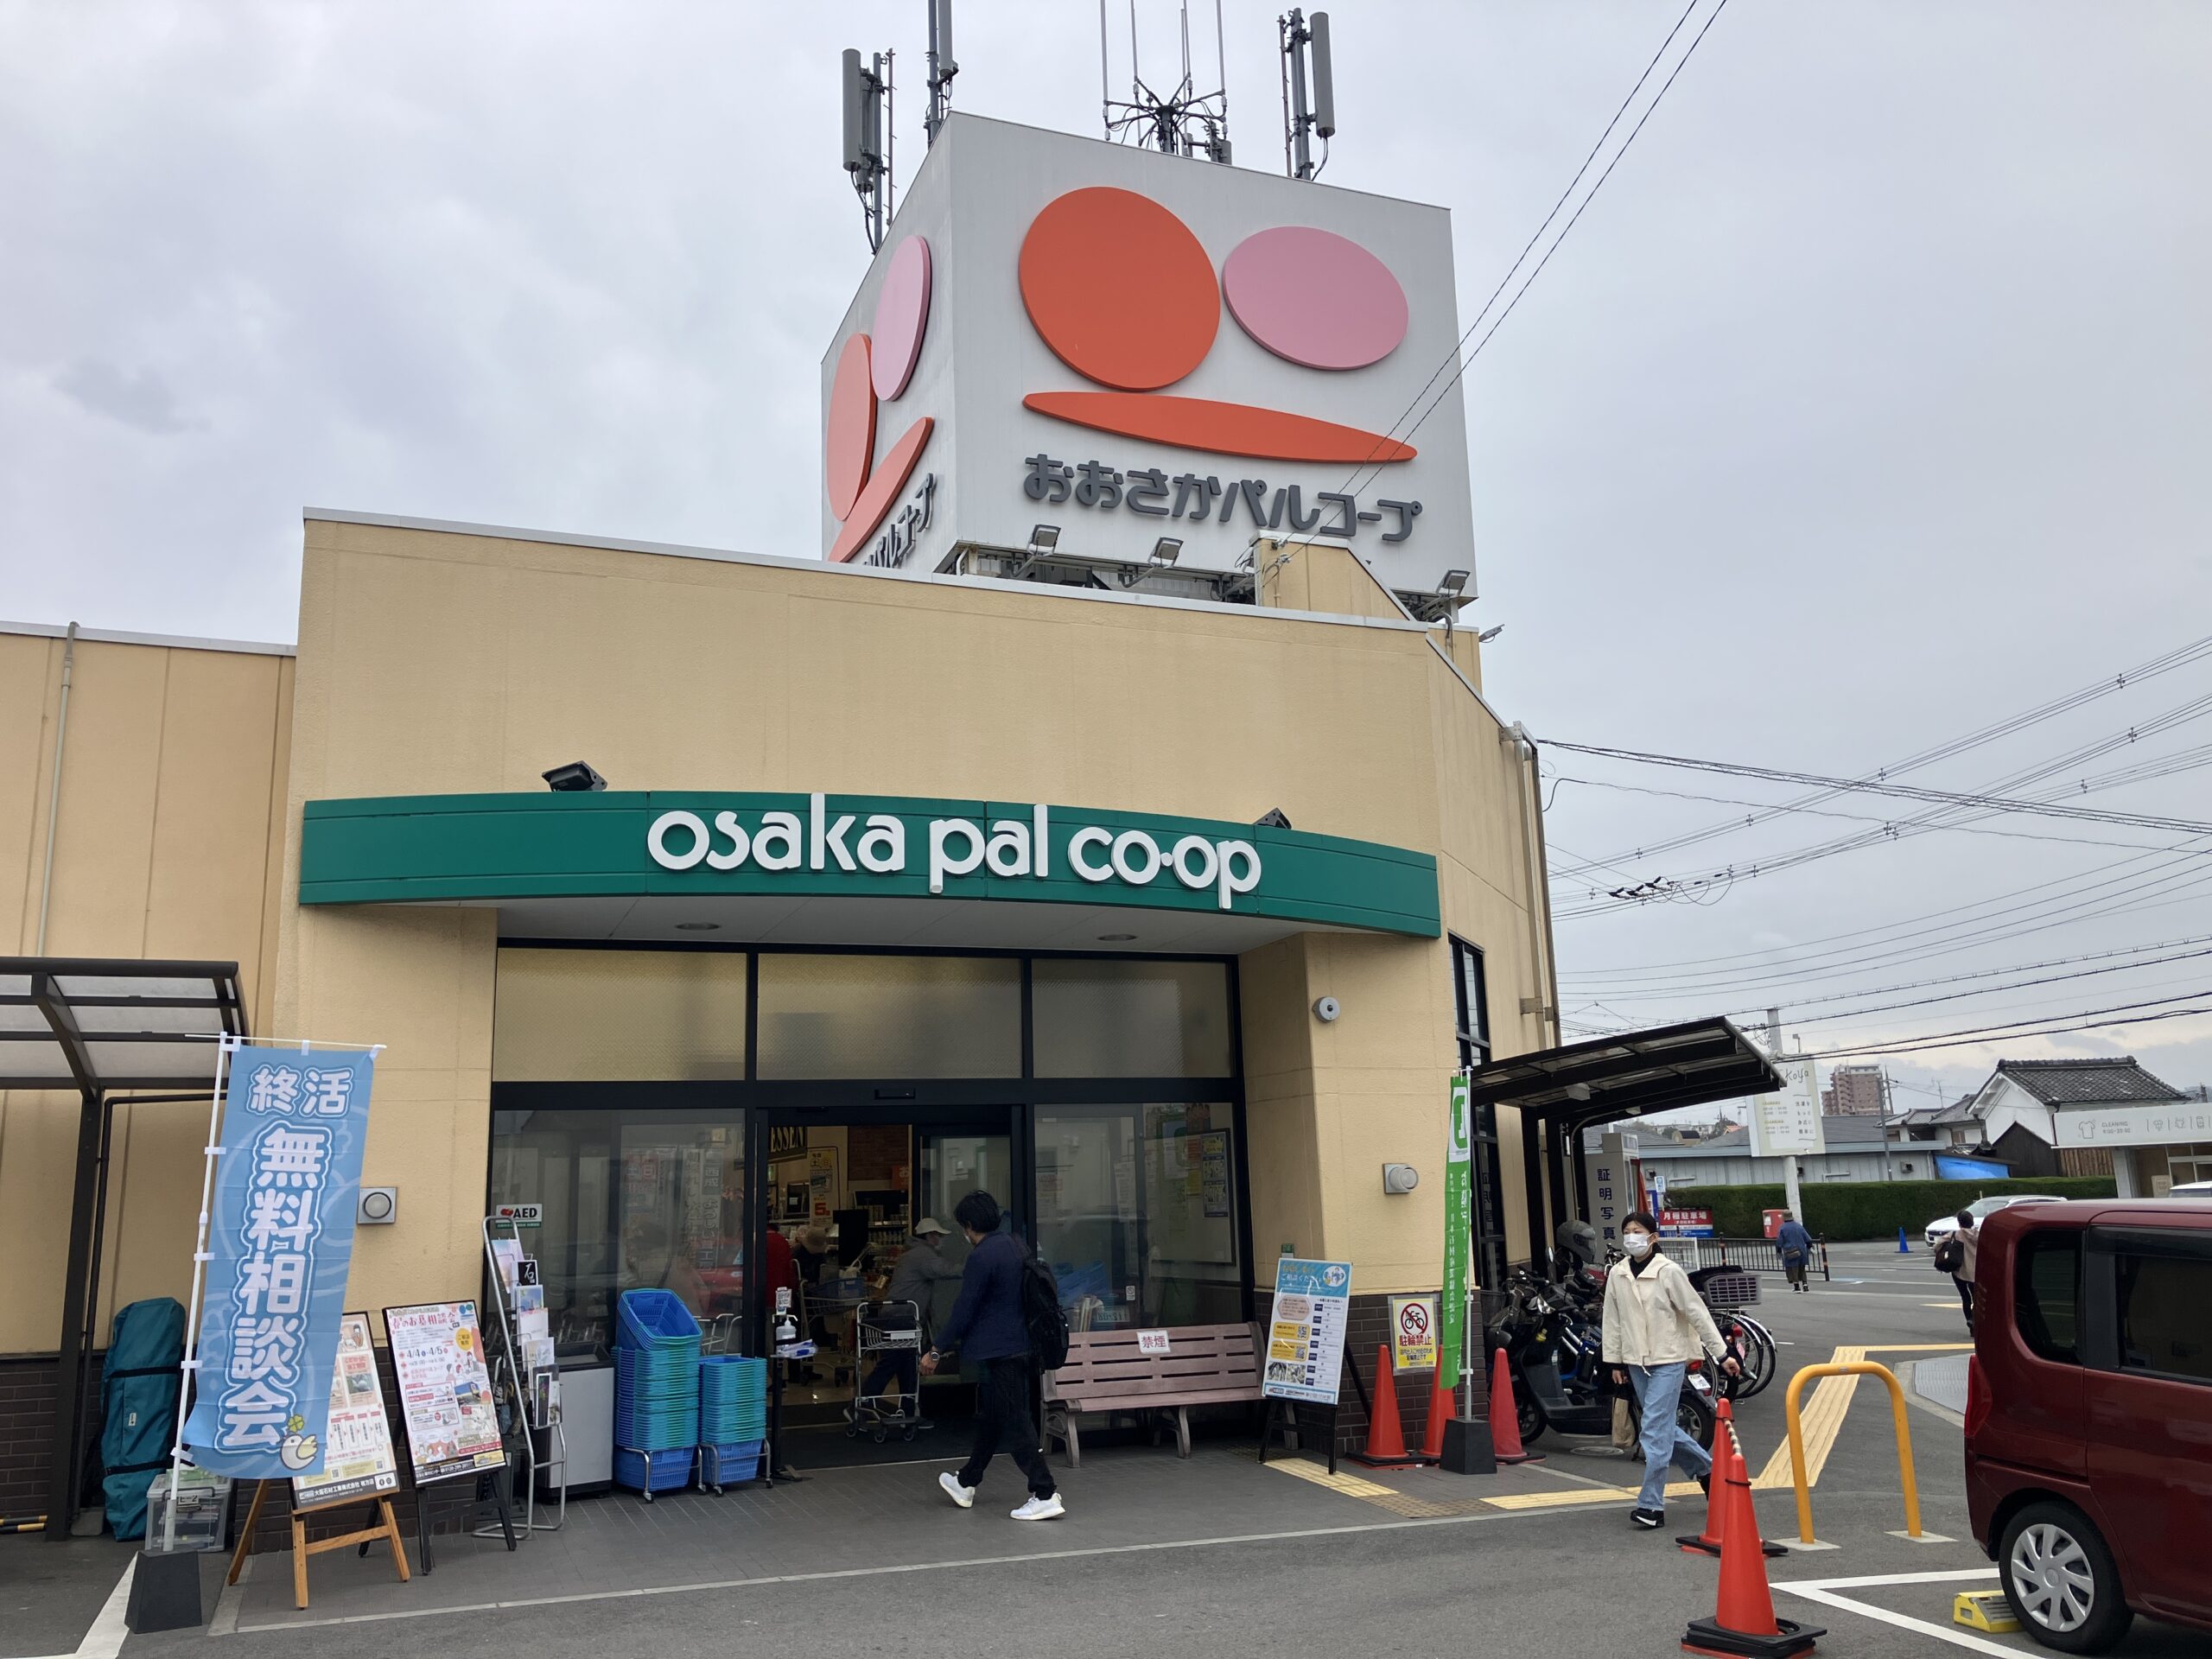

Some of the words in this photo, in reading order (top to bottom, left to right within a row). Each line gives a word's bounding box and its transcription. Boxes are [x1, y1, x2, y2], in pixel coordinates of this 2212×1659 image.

[1024, 453, 1423, 543] おおさかパルコープ
[647, 792, 906, 874] osaka
[929, 804, 1048, 893] pal
[248, 1066, 352, 1116] 終活
[513, 1207, 537, 1218] AED
[1597, 1168, 1617, 1240] 証明写真
[1663, 1211, 1707, 1221] 月極駐車場
[221, 1126, 326, 1448] 無料相談会
[1141, 1335, 1166, 1348] 禁煙
[1399, 1334, 1433, 1346] 駐輪禁止
